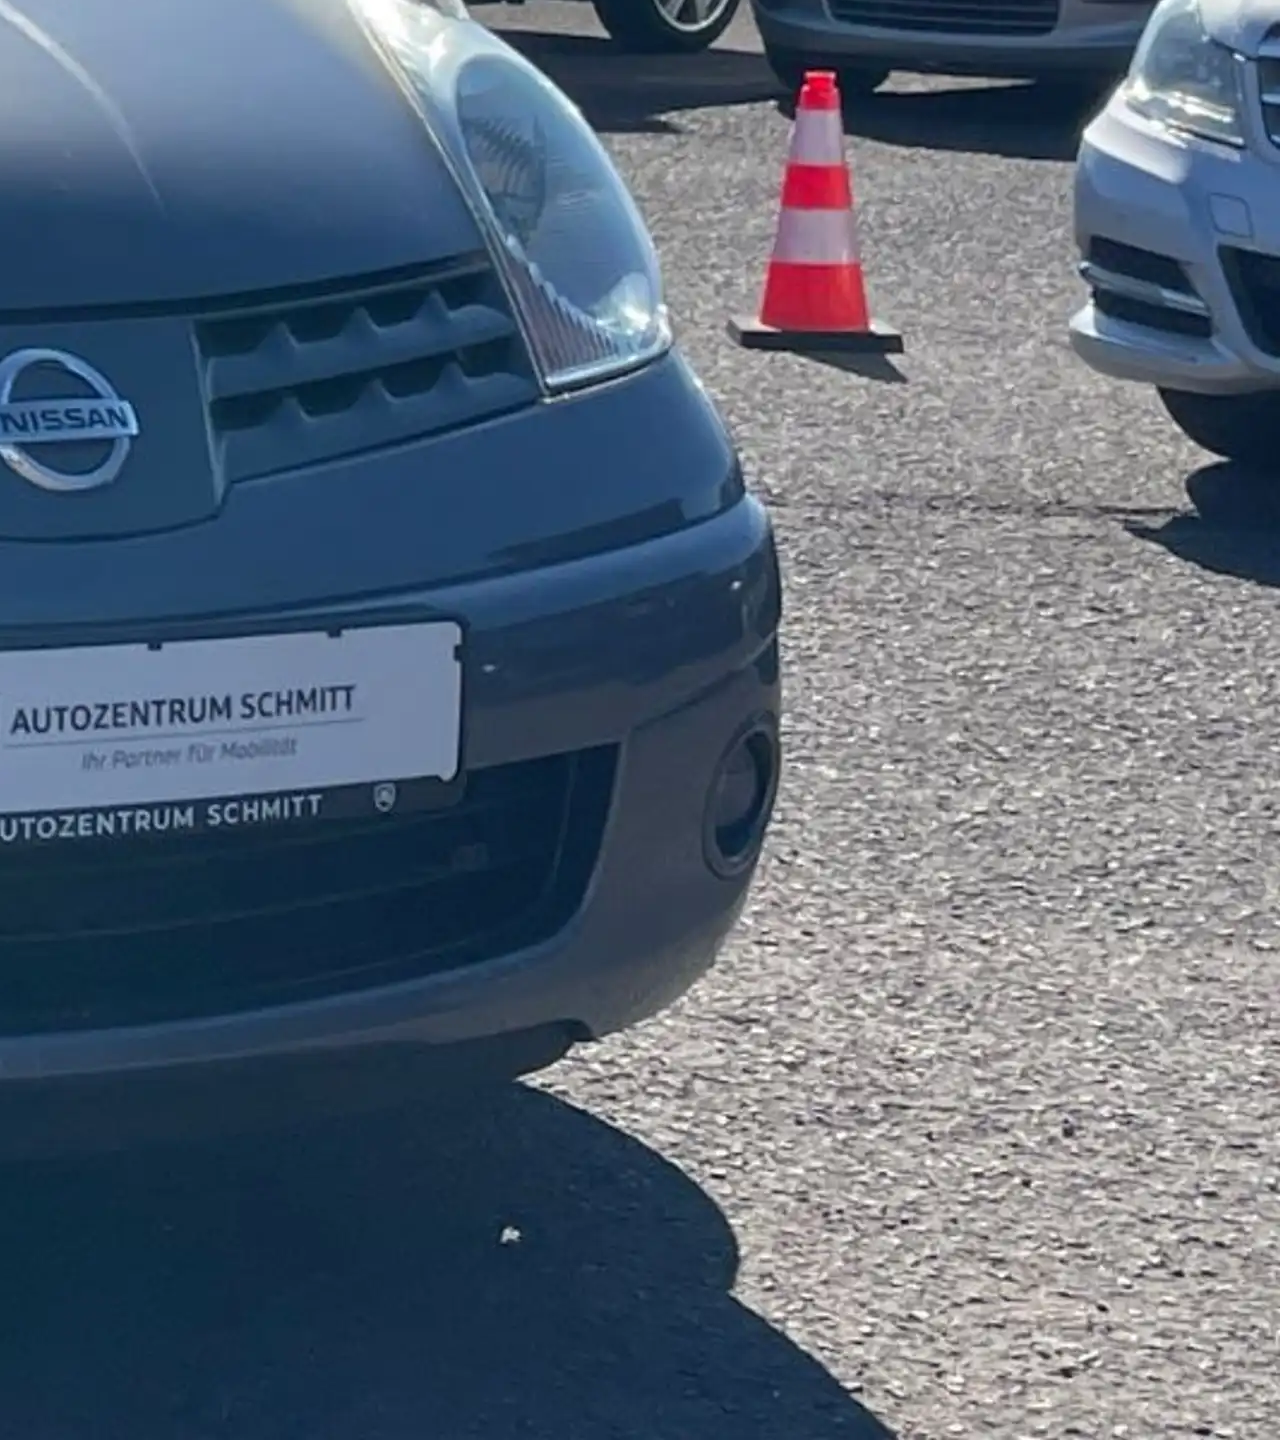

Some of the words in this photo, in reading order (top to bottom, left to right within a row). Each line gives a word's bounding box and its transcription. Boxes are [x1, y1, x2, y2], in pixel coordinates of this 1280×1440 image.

[10, 694, 232, 735] AUTOZENTRUM
[239, 684, 357, 720] SCHMITT
[81, 750, 106, 771] Ihr
[112, 747, 181, 770] Partner
[187, 742, 216, 764] für
[206, 793, 323, 827] SCHMITT
